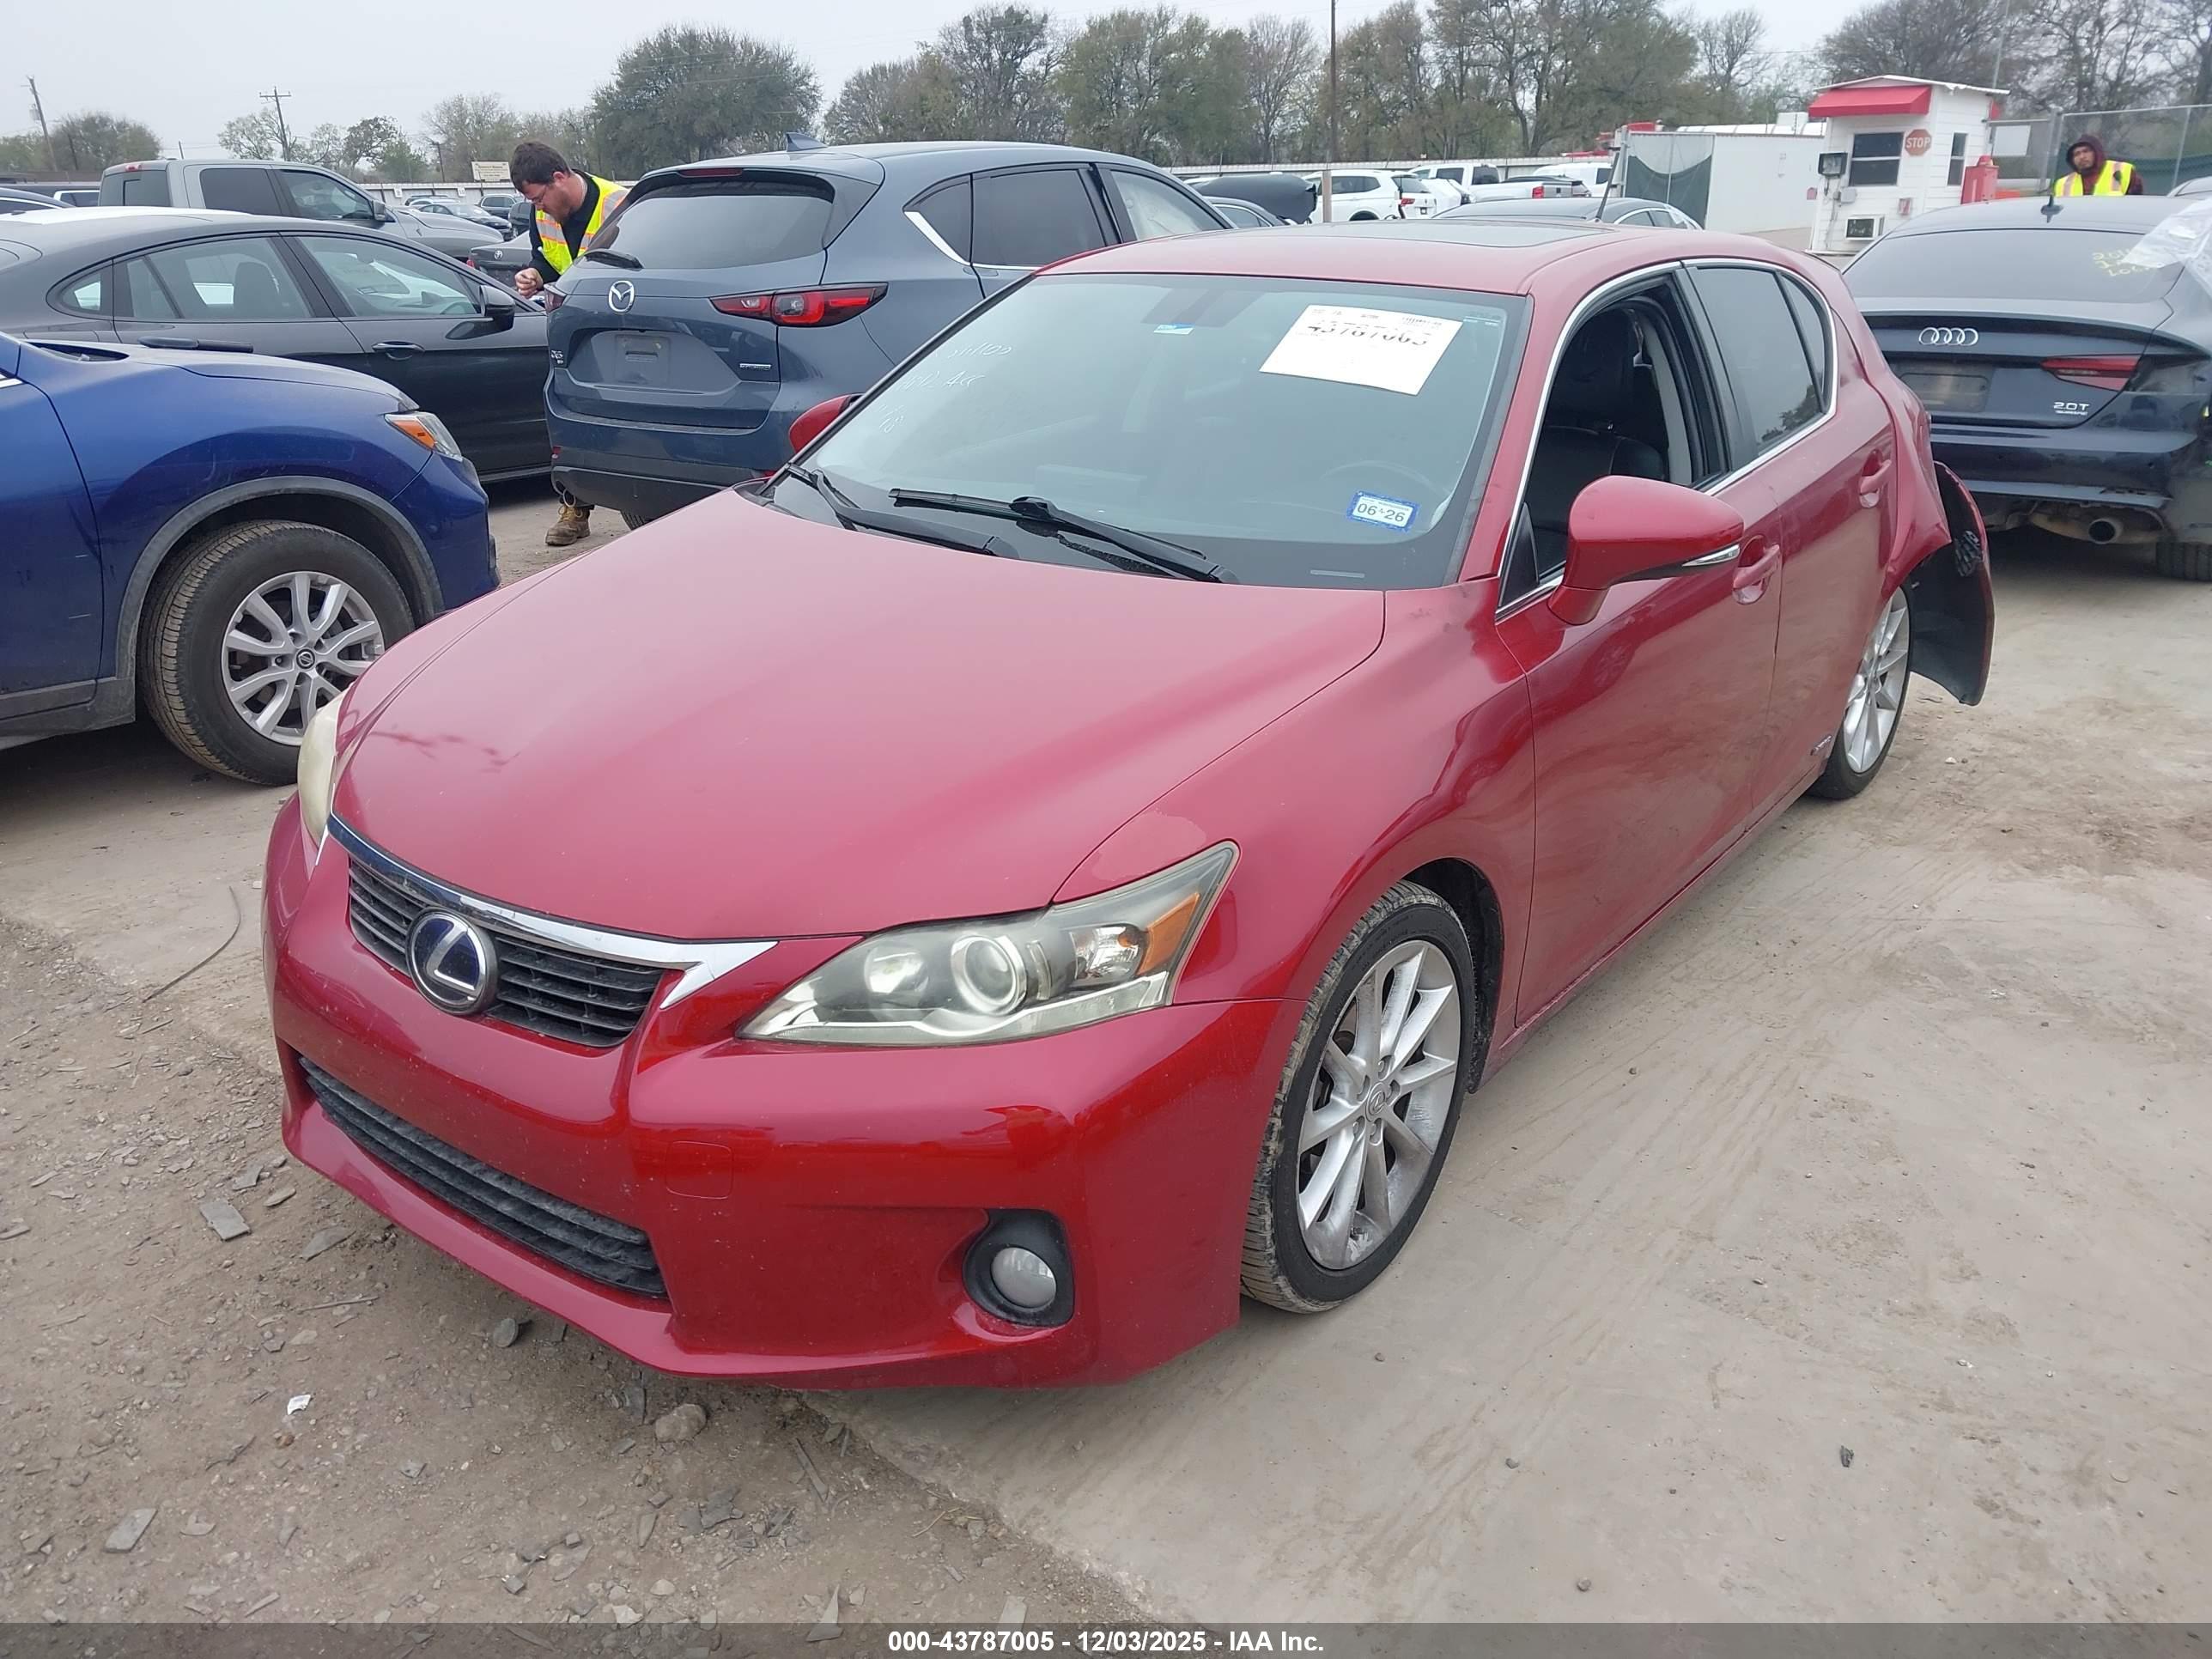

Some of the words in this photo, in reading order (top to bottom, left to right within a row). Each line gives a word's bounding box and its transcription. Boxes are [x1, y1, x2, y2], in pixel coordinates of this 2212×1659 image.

[1905, 137, 1931, 149] STOP
[1357, 503, 1377, 516] 06
[1383, 508, 1406, 522] 26
